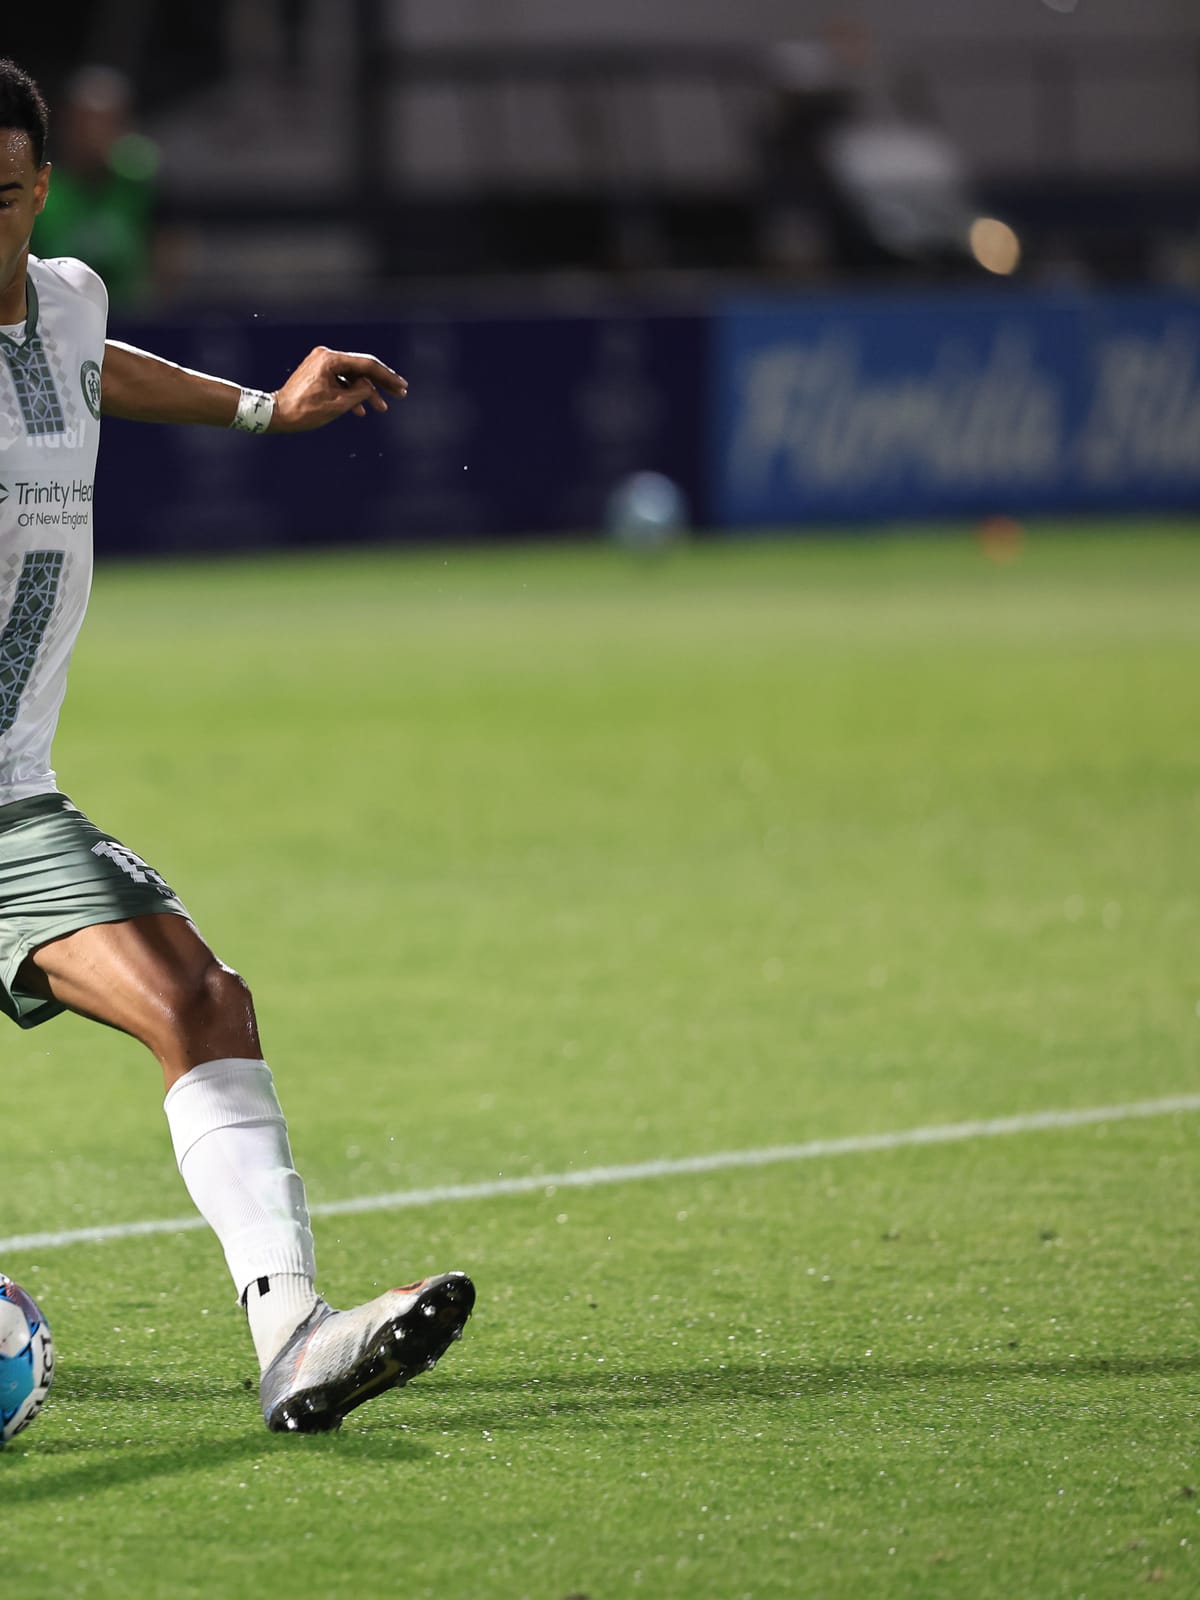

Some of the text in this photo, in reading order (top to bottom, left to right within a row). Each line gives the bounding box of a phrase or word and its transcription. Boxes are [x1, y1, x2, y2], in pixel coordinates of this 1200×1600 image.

[15, 481, 70, 509] Trinity
[17, 512, 35, 527] Of
[36, 512, 61, 526] New
